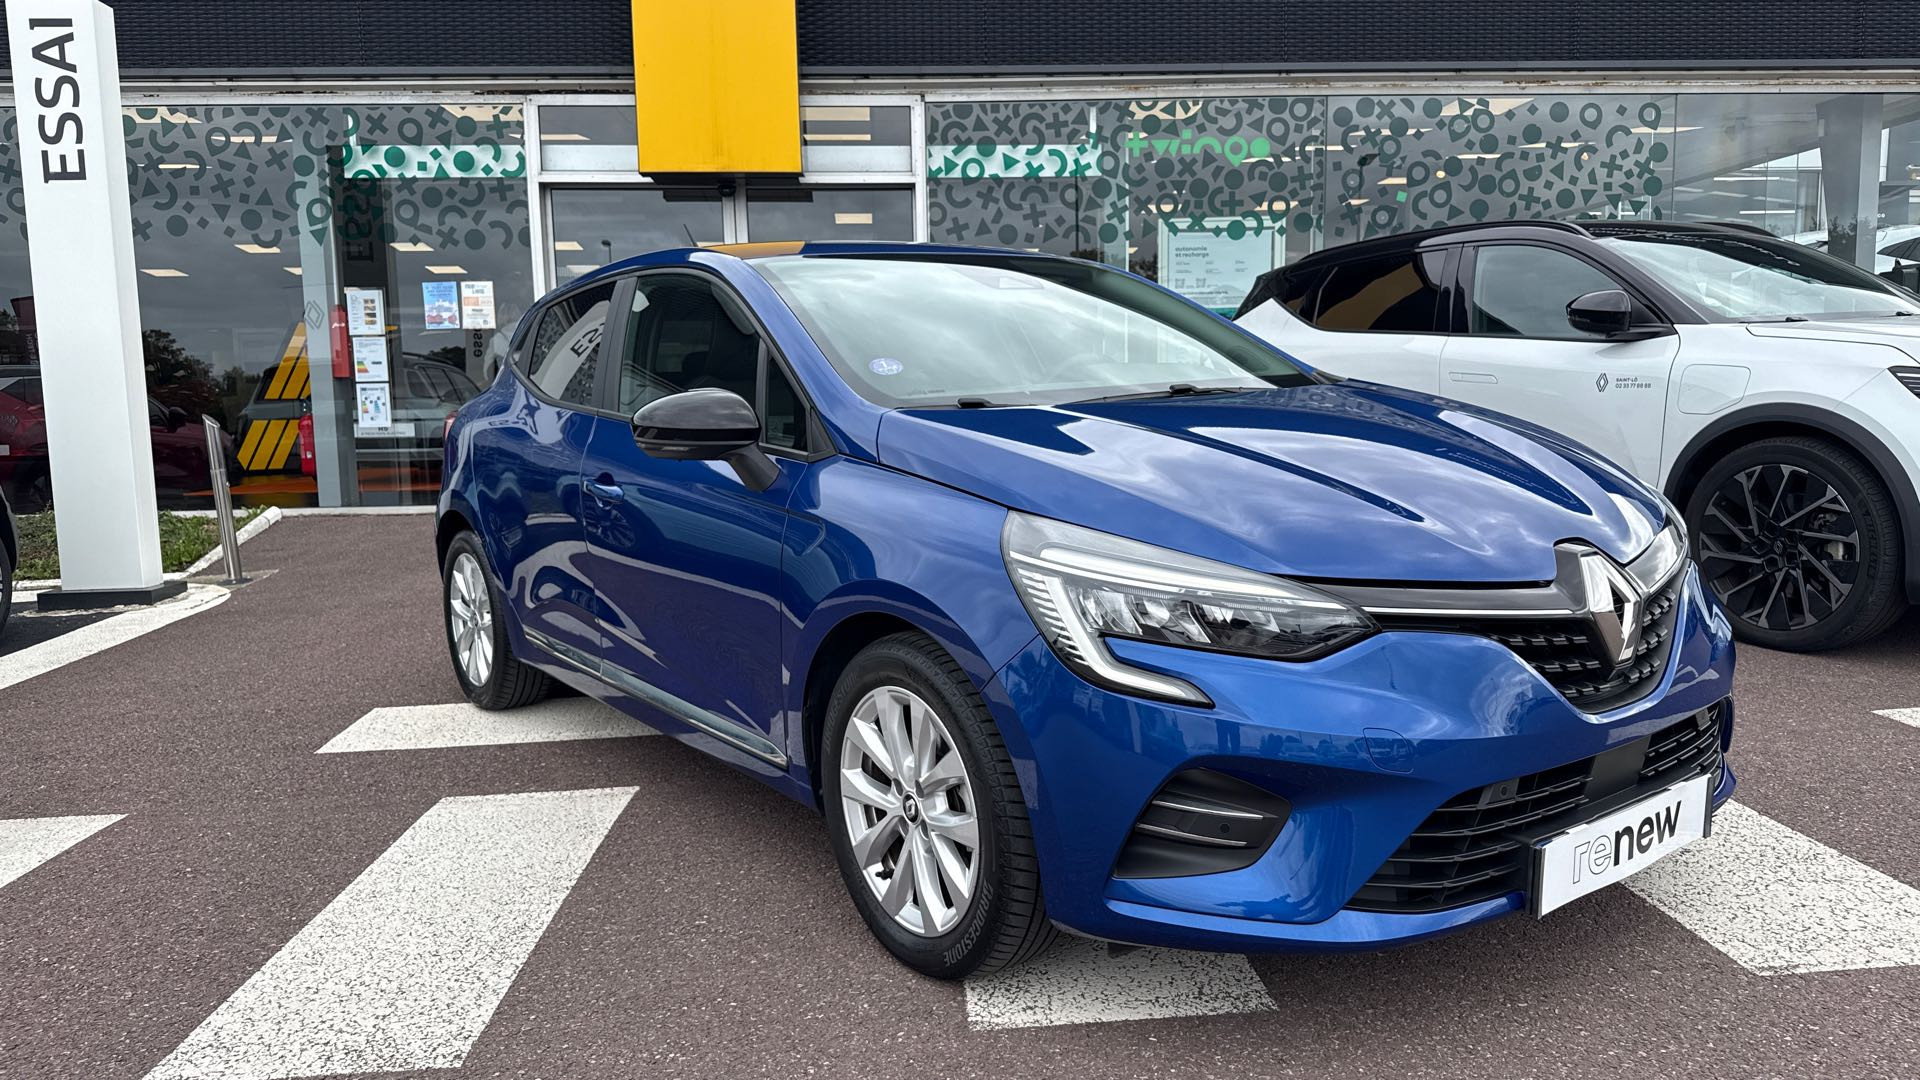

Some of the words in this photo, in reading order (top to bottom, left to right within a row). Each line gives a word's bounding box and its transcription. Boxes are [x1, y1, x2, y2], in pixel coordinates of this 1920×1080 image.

[29, 18, 86, 183] ESSAI
[1572, 799, 1682, 884] renew
[943, 877, 994, 968] BRIDGESTONE
